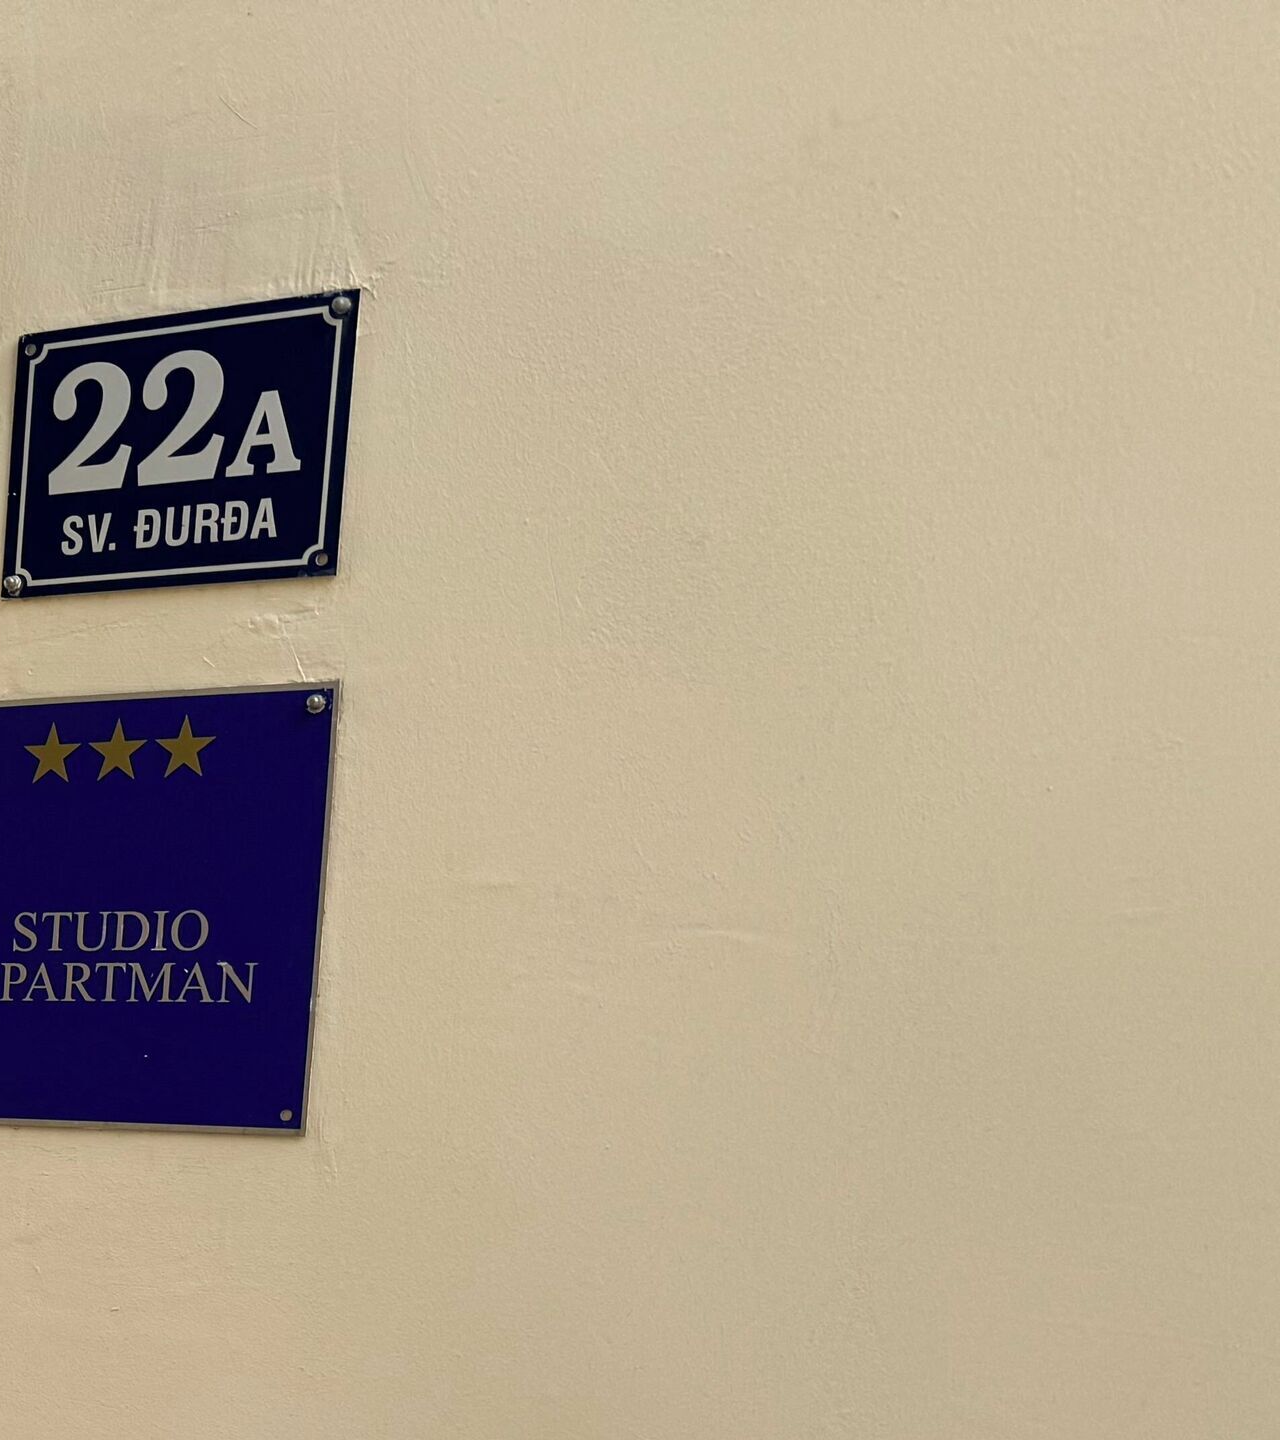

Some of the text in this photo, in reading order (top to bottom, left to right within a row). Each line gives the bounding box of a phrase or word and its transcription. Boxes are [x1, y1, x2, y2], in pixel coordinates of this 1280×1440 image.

[48, 349, 301, 496] 22A
[61, 498, 278, 556] SV. ĐURĐA
[12, 909, 210, 953] STUDIO
